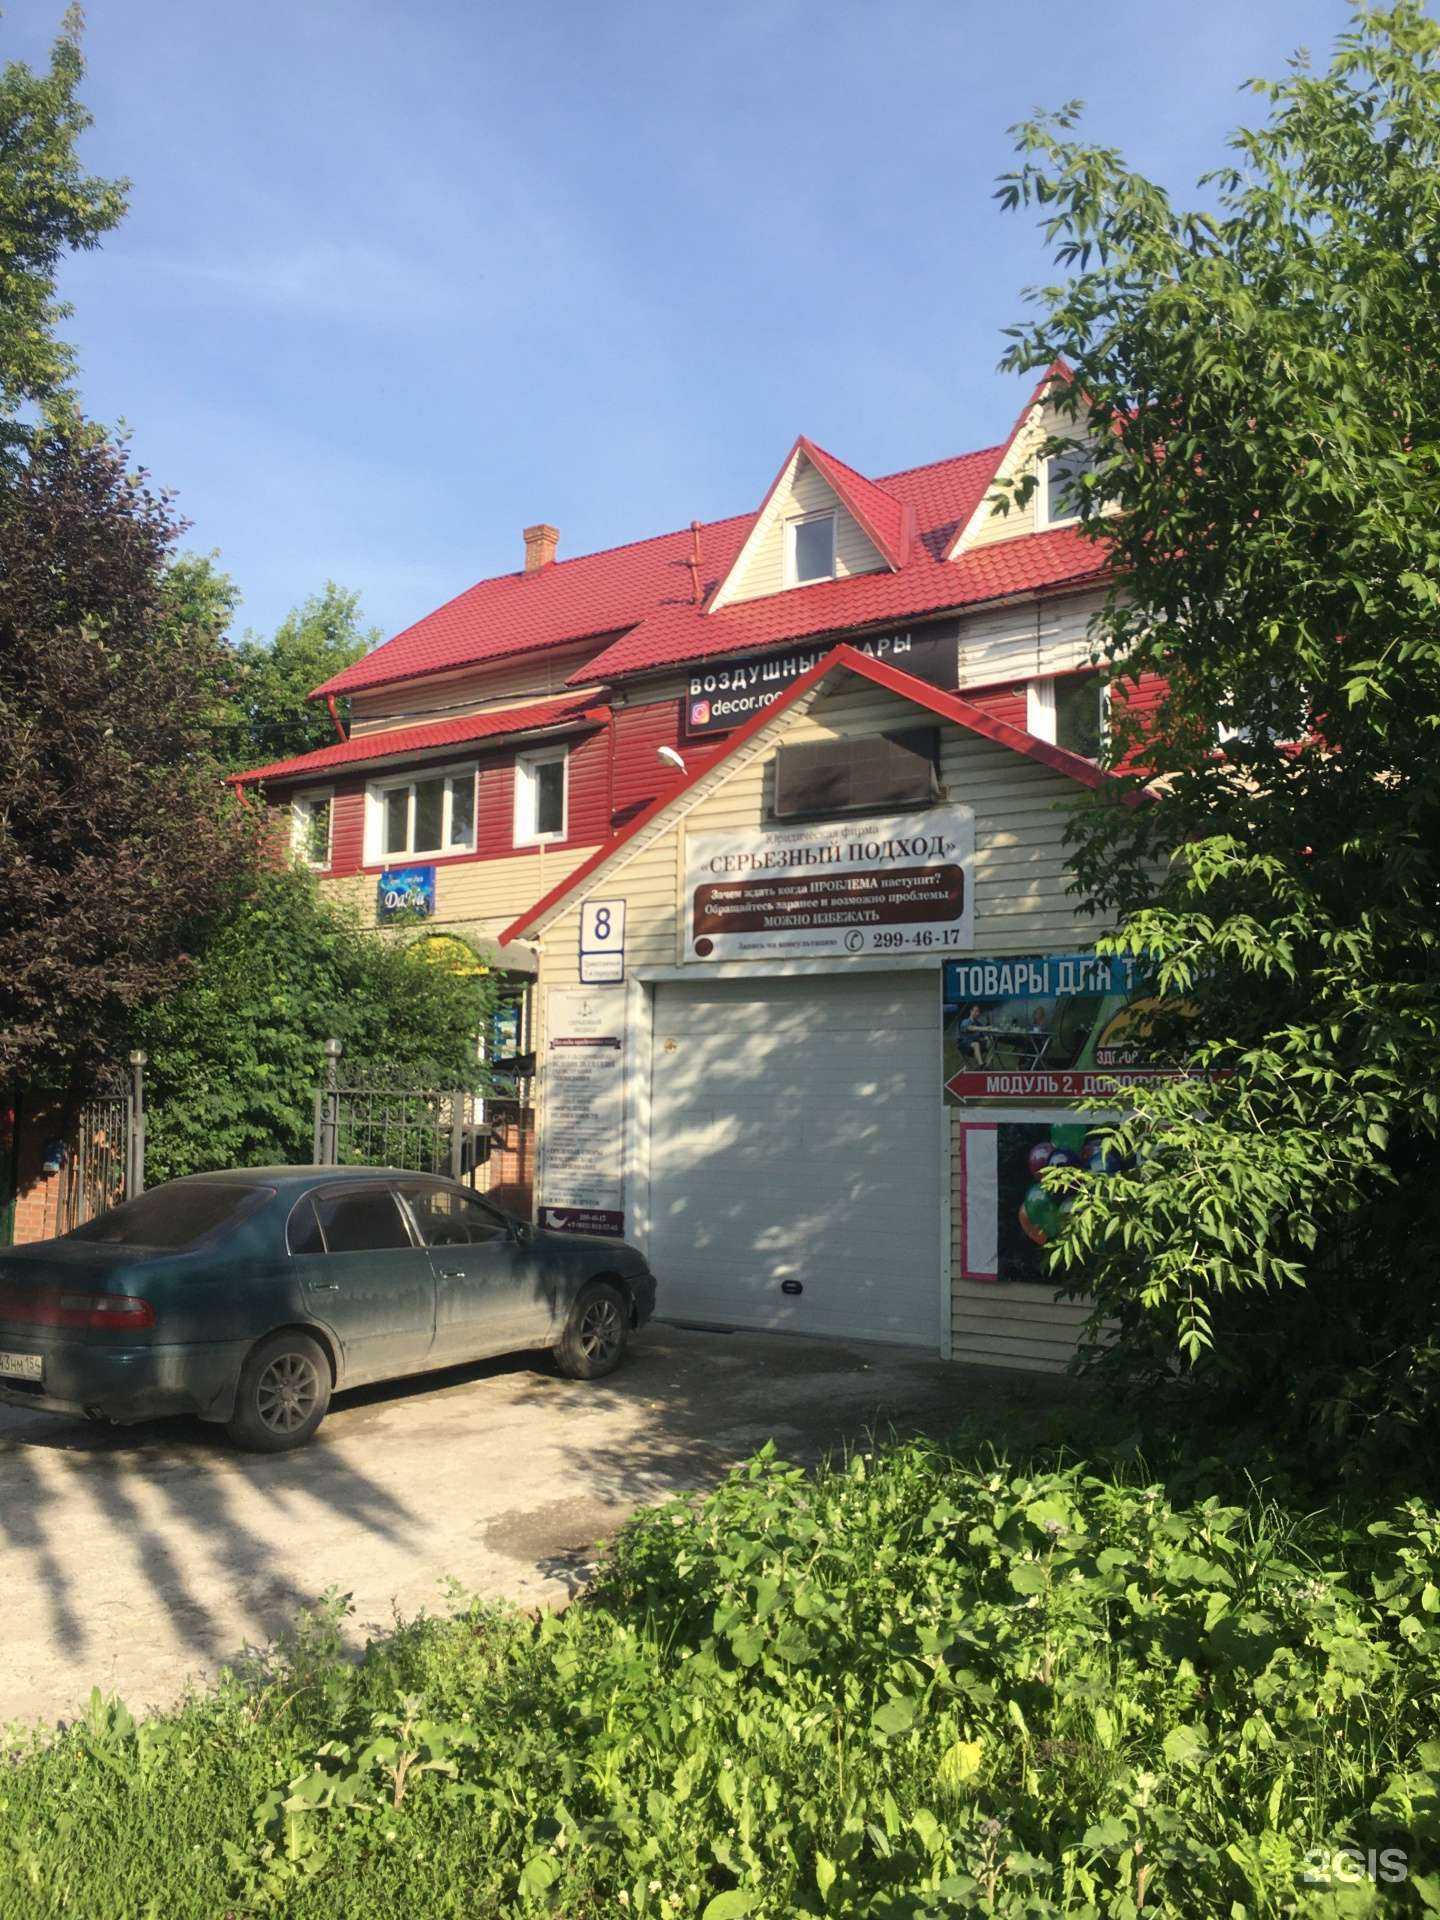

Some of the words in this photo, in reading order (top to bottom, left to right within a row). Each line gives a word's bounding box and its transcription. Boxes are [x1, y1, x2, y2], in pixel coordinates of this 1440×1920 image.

[852, 633, 912, 657] АРЫ
[701, 840, 841, 873] «СЕРЬЕЗНЫЙ
[848, 835, 956, 863] ПОДХОД»
[778, 885, 808, 897] когда
[810, 877, 878, 893] ПРОБЛЕМА
[881, 873, 941, 888] наступит?
[820, 898, 828, 907] и
[830, 893, 886, 907] возможно
[888, 889, 949, 904] проблемы
[594, 907, 611, 940] 8
[763, 914, 810, 927] МОЖНО
[812, 909, 880, 925] ИЗБЕЖАТЬ
[873, 928, 960, 948] 299-46-17
[956, 962, 1049, 996] ТОВАРЫ
[987, 1076, 1057, 1094] МОДУЛЬ
